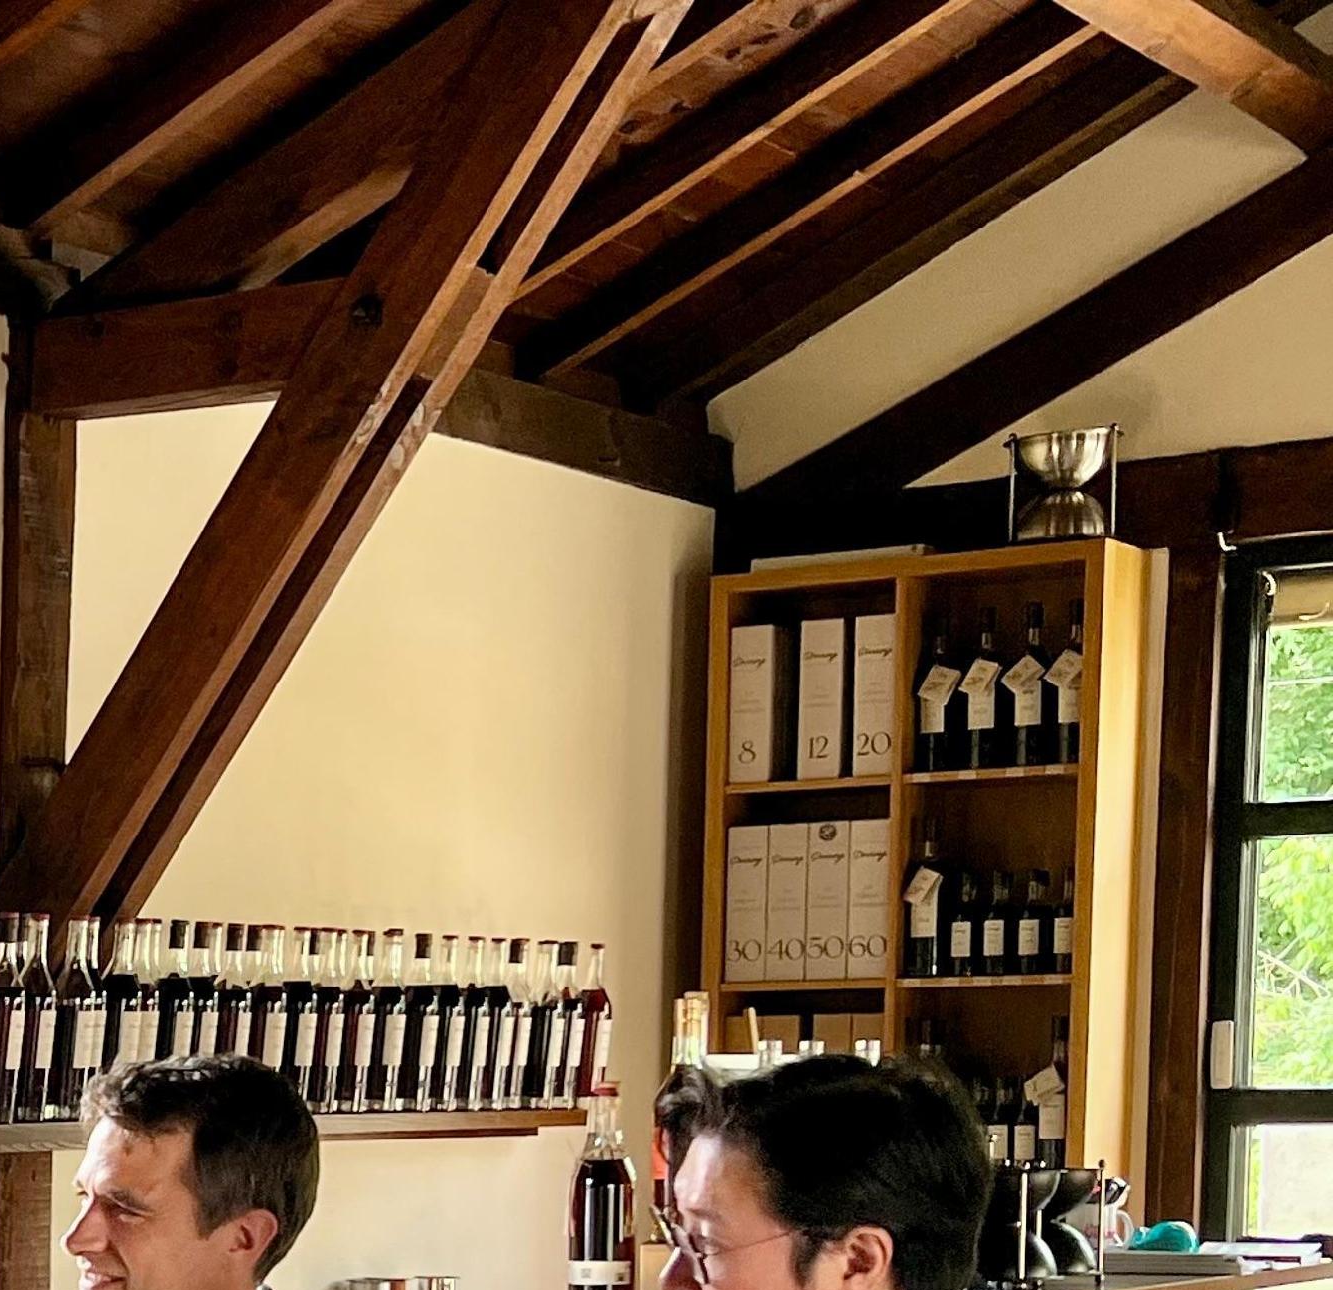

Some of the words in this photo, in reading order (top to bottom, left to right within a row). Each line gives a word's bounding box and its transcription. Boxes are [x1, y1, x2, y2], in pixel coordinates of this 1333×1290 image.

[737, 740, 757, 765] 8
[807, 735, 829, 759] 12
[856, 731, 892, 757] 20
[728, 938, 762, 962] 30
[767, 938, 806, 961] 40
[807, 935, 845, 960] 50
[848, 934, 887, 958] 60
